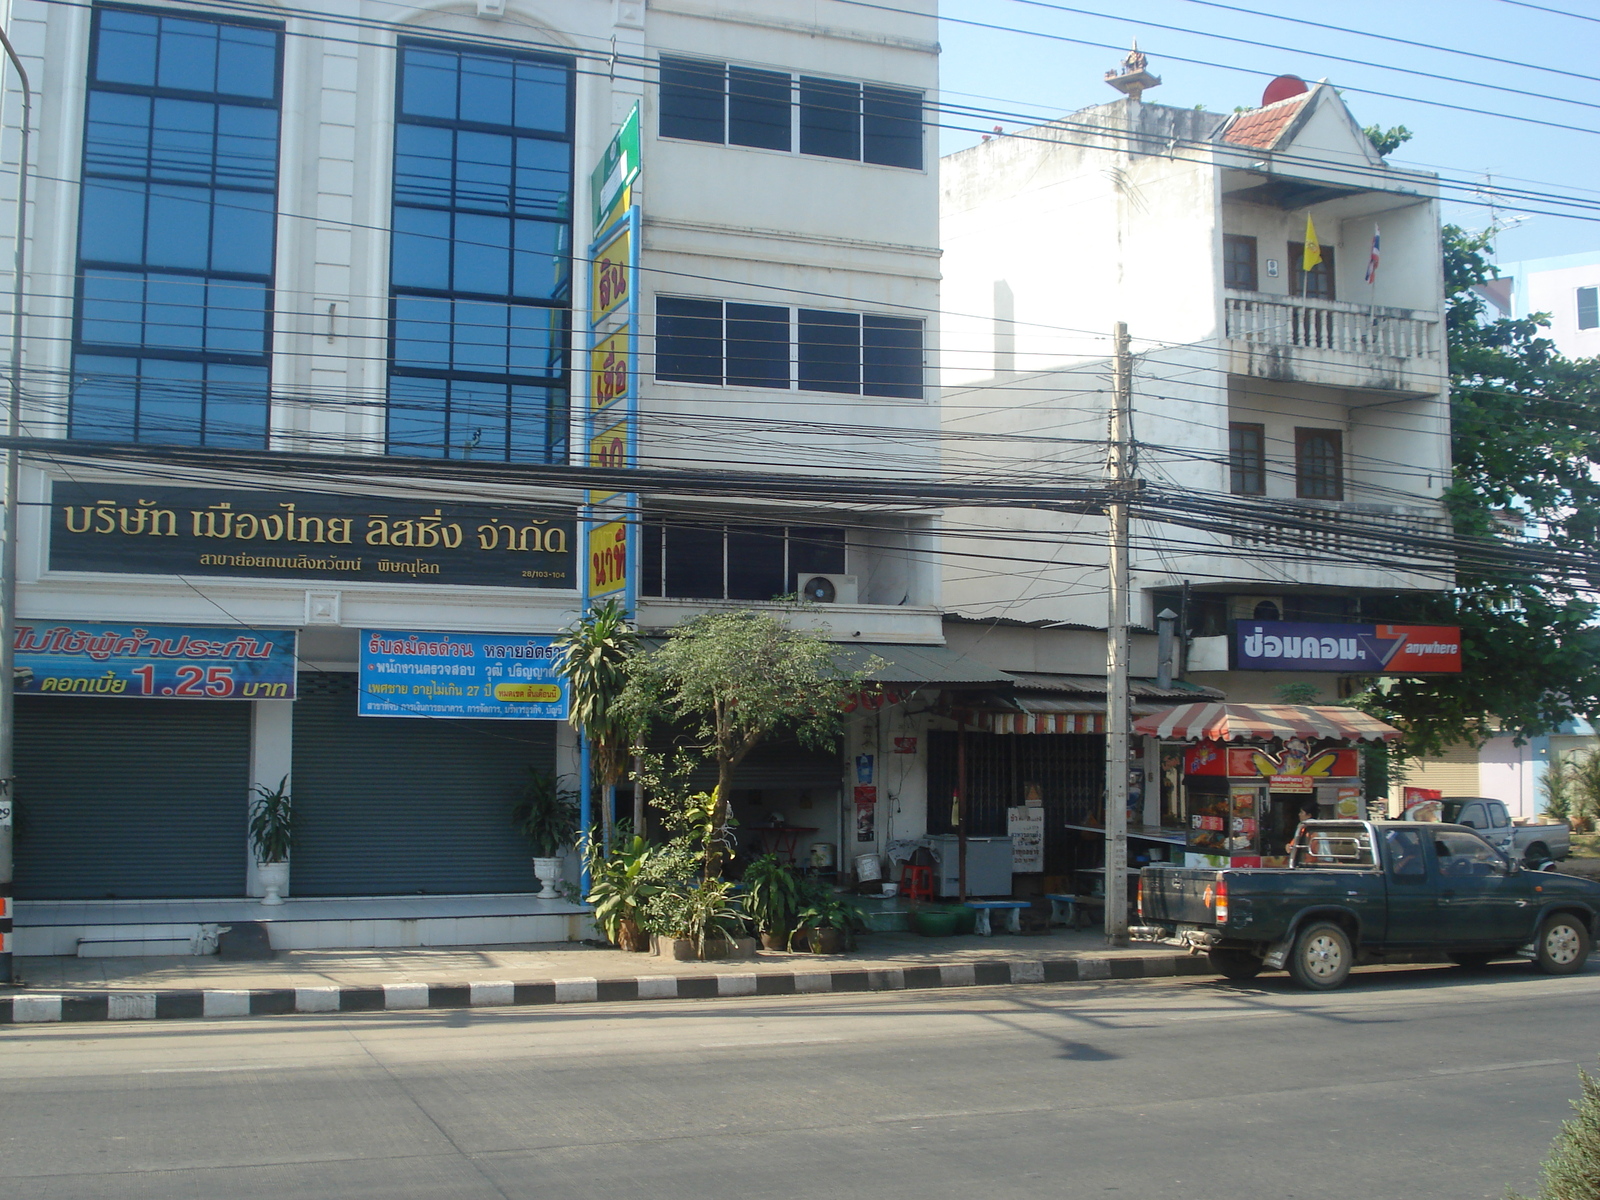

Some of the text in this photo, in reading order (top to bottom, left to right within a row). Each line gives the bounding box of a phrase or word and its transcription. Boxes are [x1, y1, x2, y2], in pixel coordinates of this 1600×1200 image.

[63, 499, 179, 537] บริษัท
[190, 502, 353, 544] เมืองไทย
[477, 518, 568, 553] จำกัด
[377, 558, 440, 577] พิษณุโลก
[593, 524, 626, 586] นาที
[521, 570, 566, 578] 28/103-104
[13, 626, 274, 661] ไม่ใช้ผู้ค้ำประกัน
[368, 632, 475, 658] รับสมัครด่วน
[1405, 641, 1459, 657] anywhere
[40, 664, 288, 698] ดอกเบี้ย 1.25 บาท
[376, 658, 476, 676] พนักงานตรวจสอบ
[485, 662, 503, 682] วุฒิ
[368, 680, 492, 700] เพศชาย อายุไม่เกิน 27 ปี
